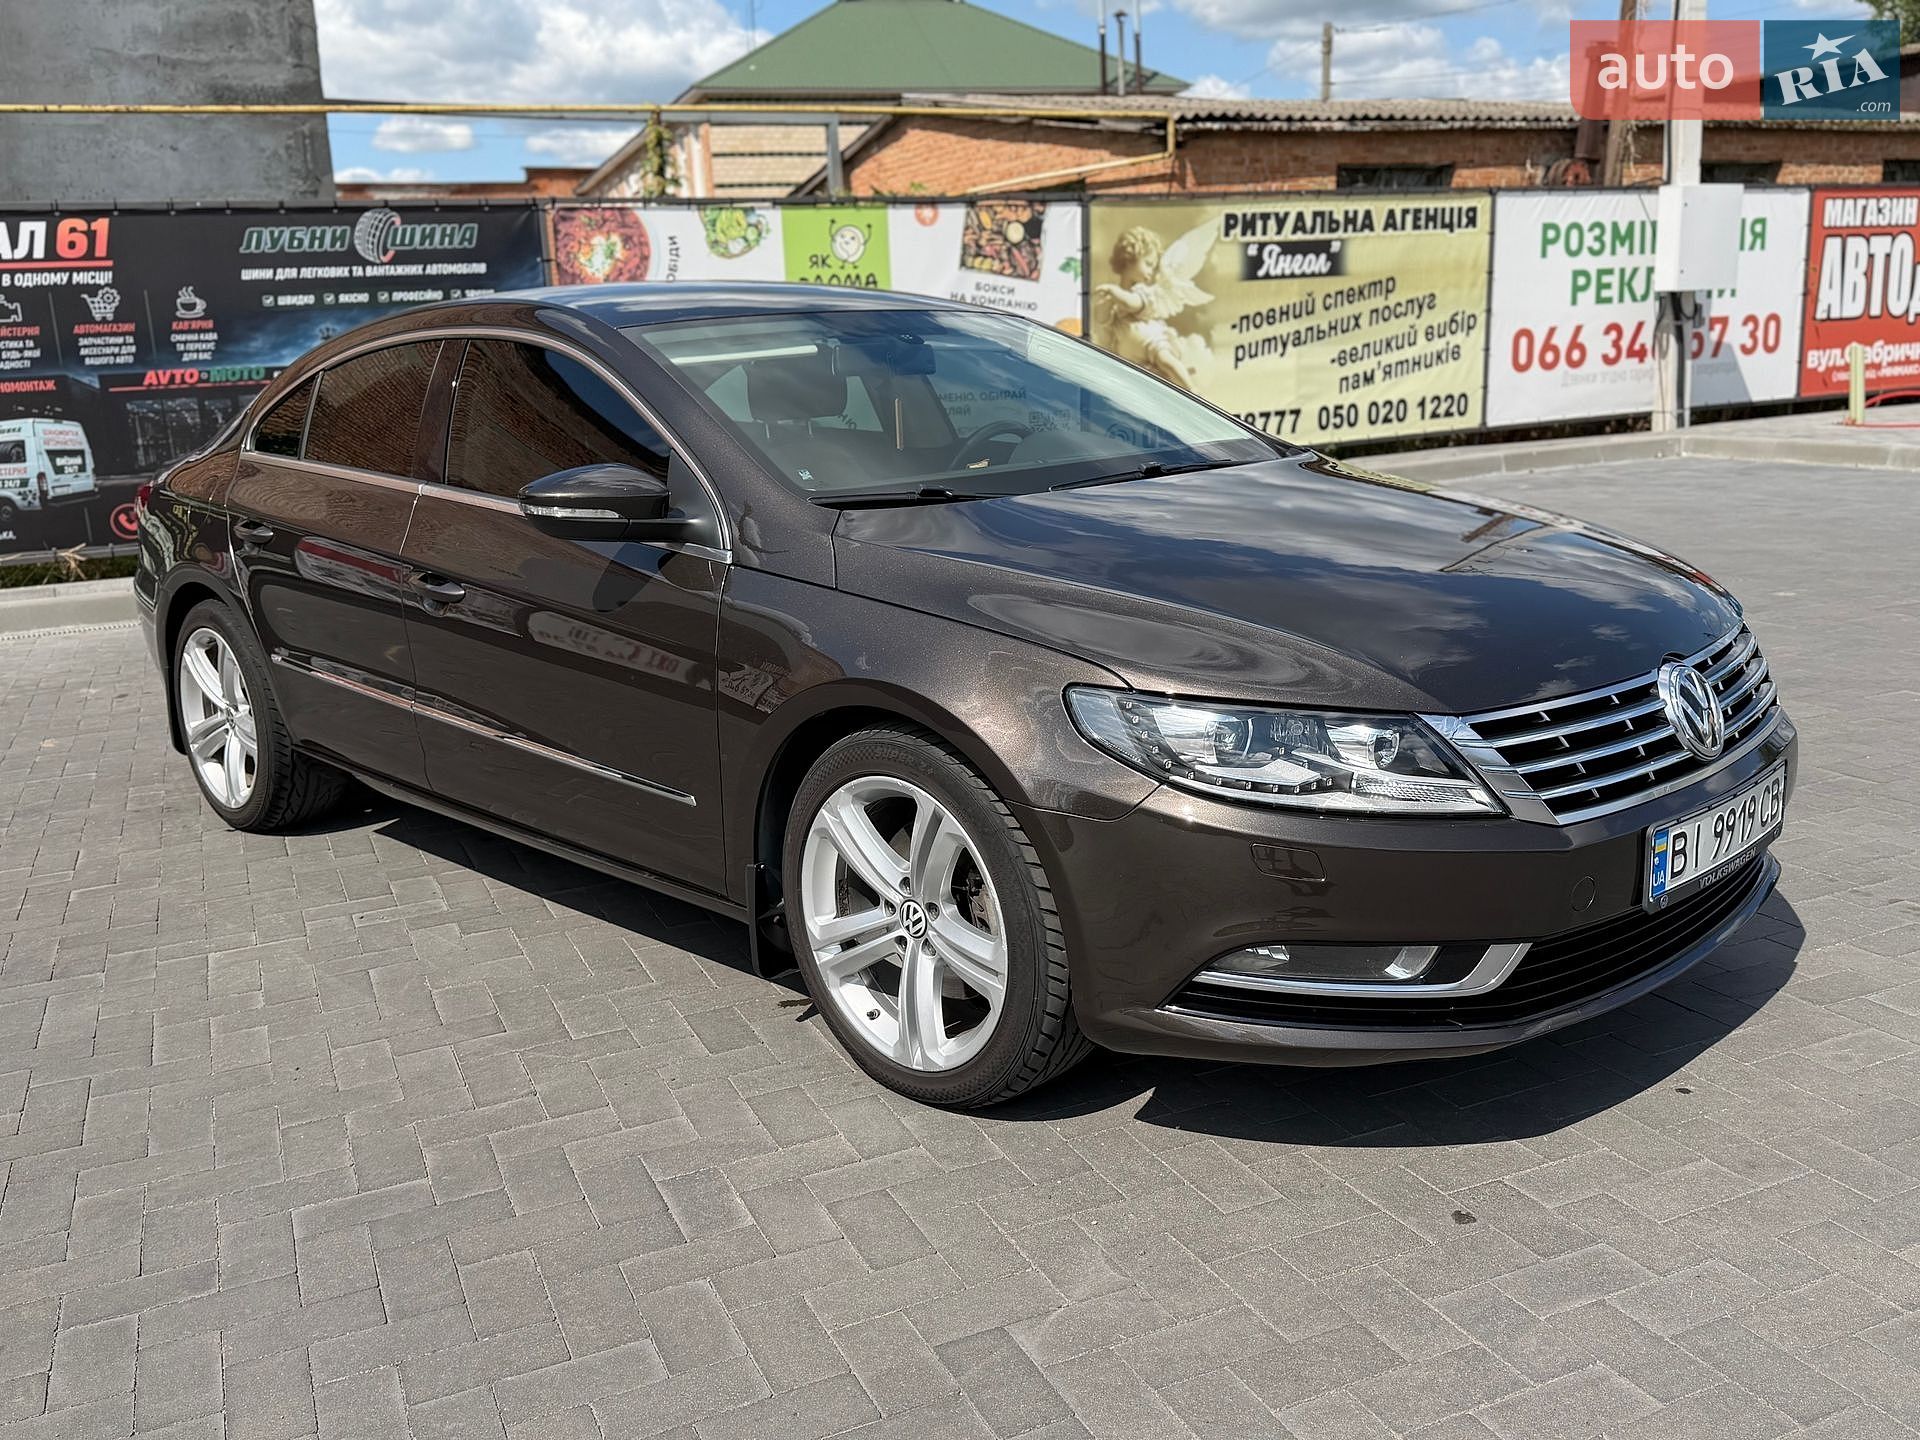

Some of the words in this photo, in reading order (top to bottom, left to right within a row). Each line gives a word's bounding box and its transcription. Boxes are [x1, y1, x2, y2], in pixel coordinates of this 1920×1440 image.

[1224, 209, 1375, 237] РИТУАЛЬНА
[1383, 206, 1478, 232] АГЕНЦІЯ
[1823, 198, 1918, 227] МАГАЗИН
[56, 217, 110, 260] 61
[240, 225, 350, 253] ЛУБНИ
[387, 223, 478, 249] ШИНА
[1541, 217, 1767, 258] РОЗМІЯ
[241, 268, 273, 281] ШИНИ
[275, 267, 297, 281] ДЛЯ
[299, 266, 350, 280] ЛЕГКОВИХ
[352, 265, 364, 278] ТА
[365, 264, 424, 278] ВАНТАЖНИХ
[425, 262, 487, 275] АВТОМОБІЛІВ
[809, 255, 831, 269] ЯК
[2, 273, 11, 286] В
[14, 272, 69, 288] ОДНОМУ
[72, 271, 113, 286] МІСЦІ!
[975, 282, 1015, 295] БОКСИ
[277, 294, 315, 306] ШВИДКО
[338, 293, 369, 304] ЯКІСНО
[392, 289, 443, 302] ПРОФЕСІЙНО
[950, 291, 967, 303] НА
[971, 294, 1038, 312] КОМПАНІЮ
[1231, 290, 1316, 334] -повний
[1323, 276, 1396, 311] спектр
[73, 323, 136, 334] АВТОМАГАЗИН
[78, 336, 124, 346] ЗАПЧАСТИНИ
[125, 335, 134, 344] ТА
[199, 331, 218, 341] КАВА
[1234, 312, 1361, 369] ритуальних
[1369, 292, 1437, 327] послуг
[1330, 325, 1417, 369] -великий
[1425, 310, 1477, 342] вибір
[79, 346, 120, 356] АКСЕСУАРИ
[121, 344, 136, 355] ДЛЯ
[176, 342, 185, 351] ТА
[185, 341, 216, 351] ПЕРЕКУС
[1511, 325, 1587, 373] 066
[1601, 321, 1656, 366] 34
[1739, 313, 1781, 356] 30
[85, 355, 114, 366] ВАШОГО
[115, 354, 134, 365] АВТО
[1339, 343, 1461, 394] пам'ятників
[1318, 404, 1358, 430] 050
[1367, 399, 1407, 425] 020
[1417, 393, 1469, 419] 1220
[1669, 822, 1701, 880] BI
[1711, 795, 1756, 861] 9919
[1759, 777, 1780, 827] CB
[1652, 872, 1665, 887] UA
[1700, 846, 1757, 889] VOLKSWAGEN
